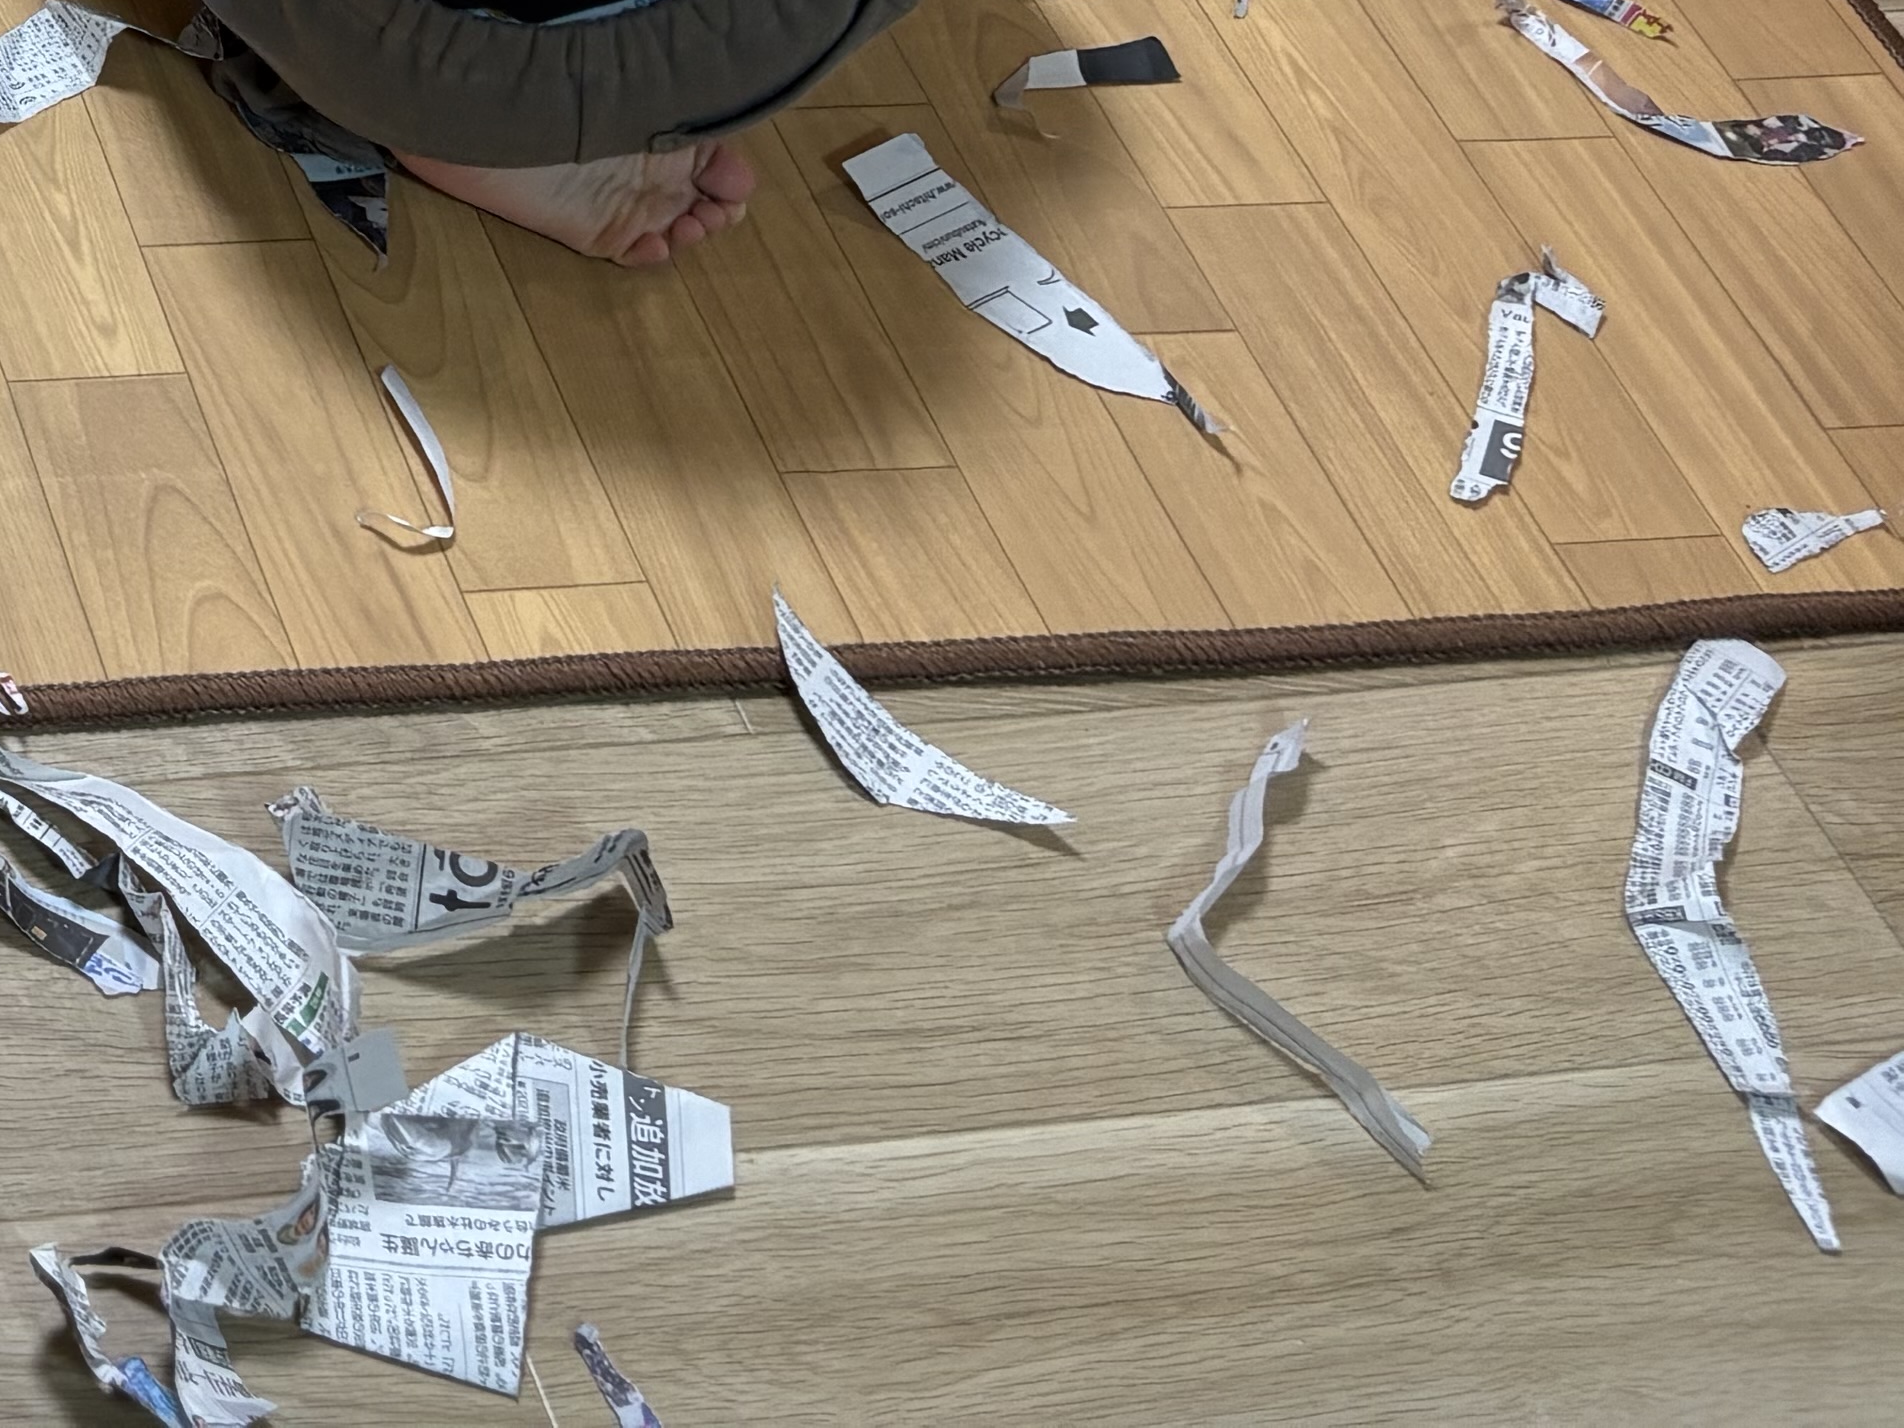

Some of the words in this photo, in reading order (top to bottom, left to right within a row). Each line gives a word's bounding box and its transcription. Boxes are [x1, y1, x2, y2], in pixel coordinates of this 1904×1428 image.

[590, 1060, 616, 1203] 小売業者に対し
